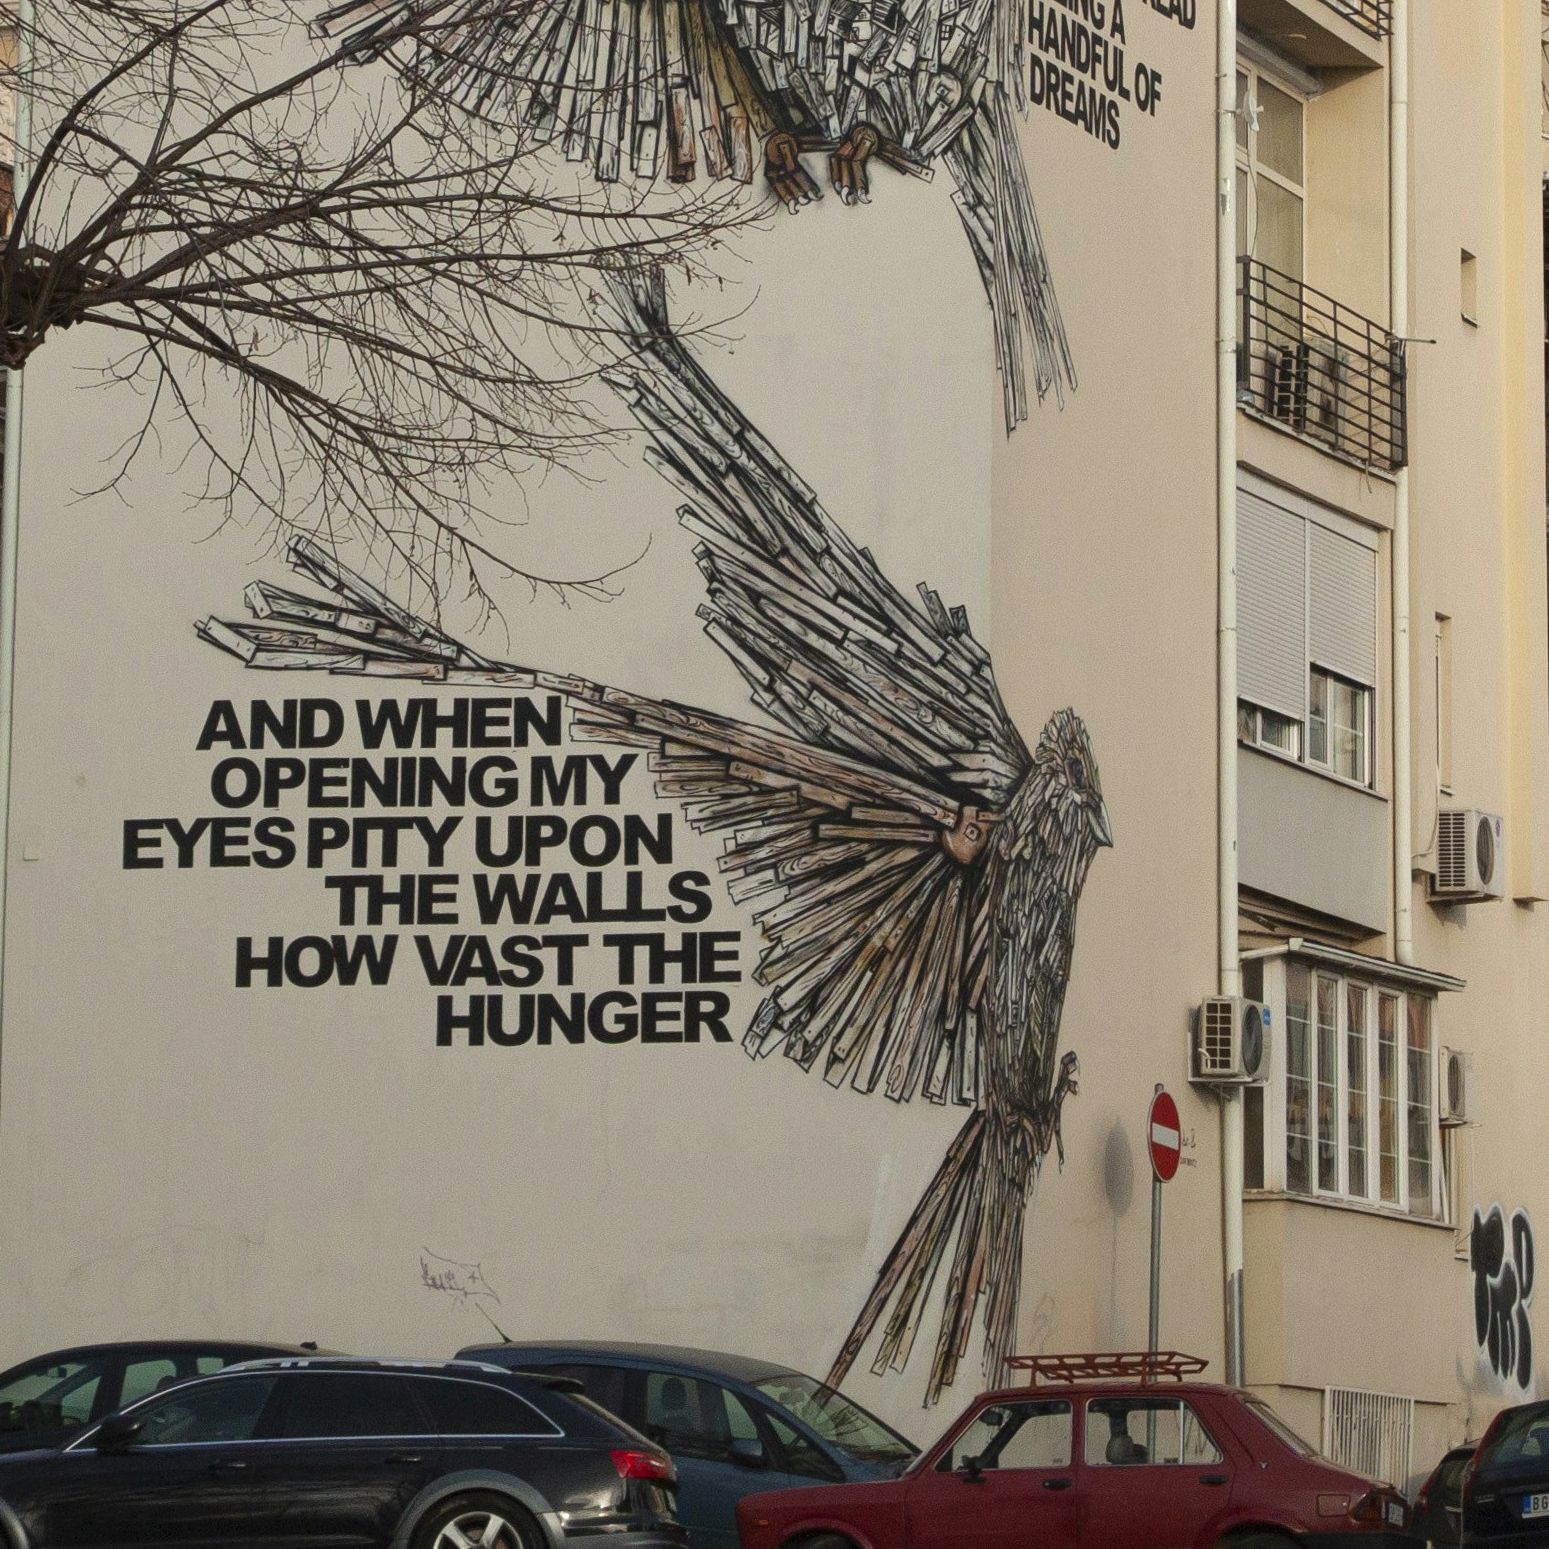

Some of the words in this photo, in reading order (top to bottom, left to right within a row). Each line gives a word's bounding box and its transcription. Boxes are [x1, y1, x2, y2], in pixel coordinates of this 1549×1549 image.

[1030, 52, 1120, 150] DREAMS
[1135, 62, 1162, 117] OF
[196, 698, 345, 751] AND
[355, 695, 562, 750] WHEN
[211, 755, 519, 809] OPENING
[530, 753, 638, 807] MY
[123, 816, 296, 870] EYES
[307, 816, 463, 869] PITY
[475, 813, 673, 867] UPON
[325, 874, 459, 926] THE
[473, 870, 713, 925] WALLS
[235, 934, 398, 988] HOW
[414, 934, 589, 987] VAST
[603, 931, 742, 985] THE
[436, 990, 733, 1047] HUNGER
[1532, 1496, 1548, 1510] BG
